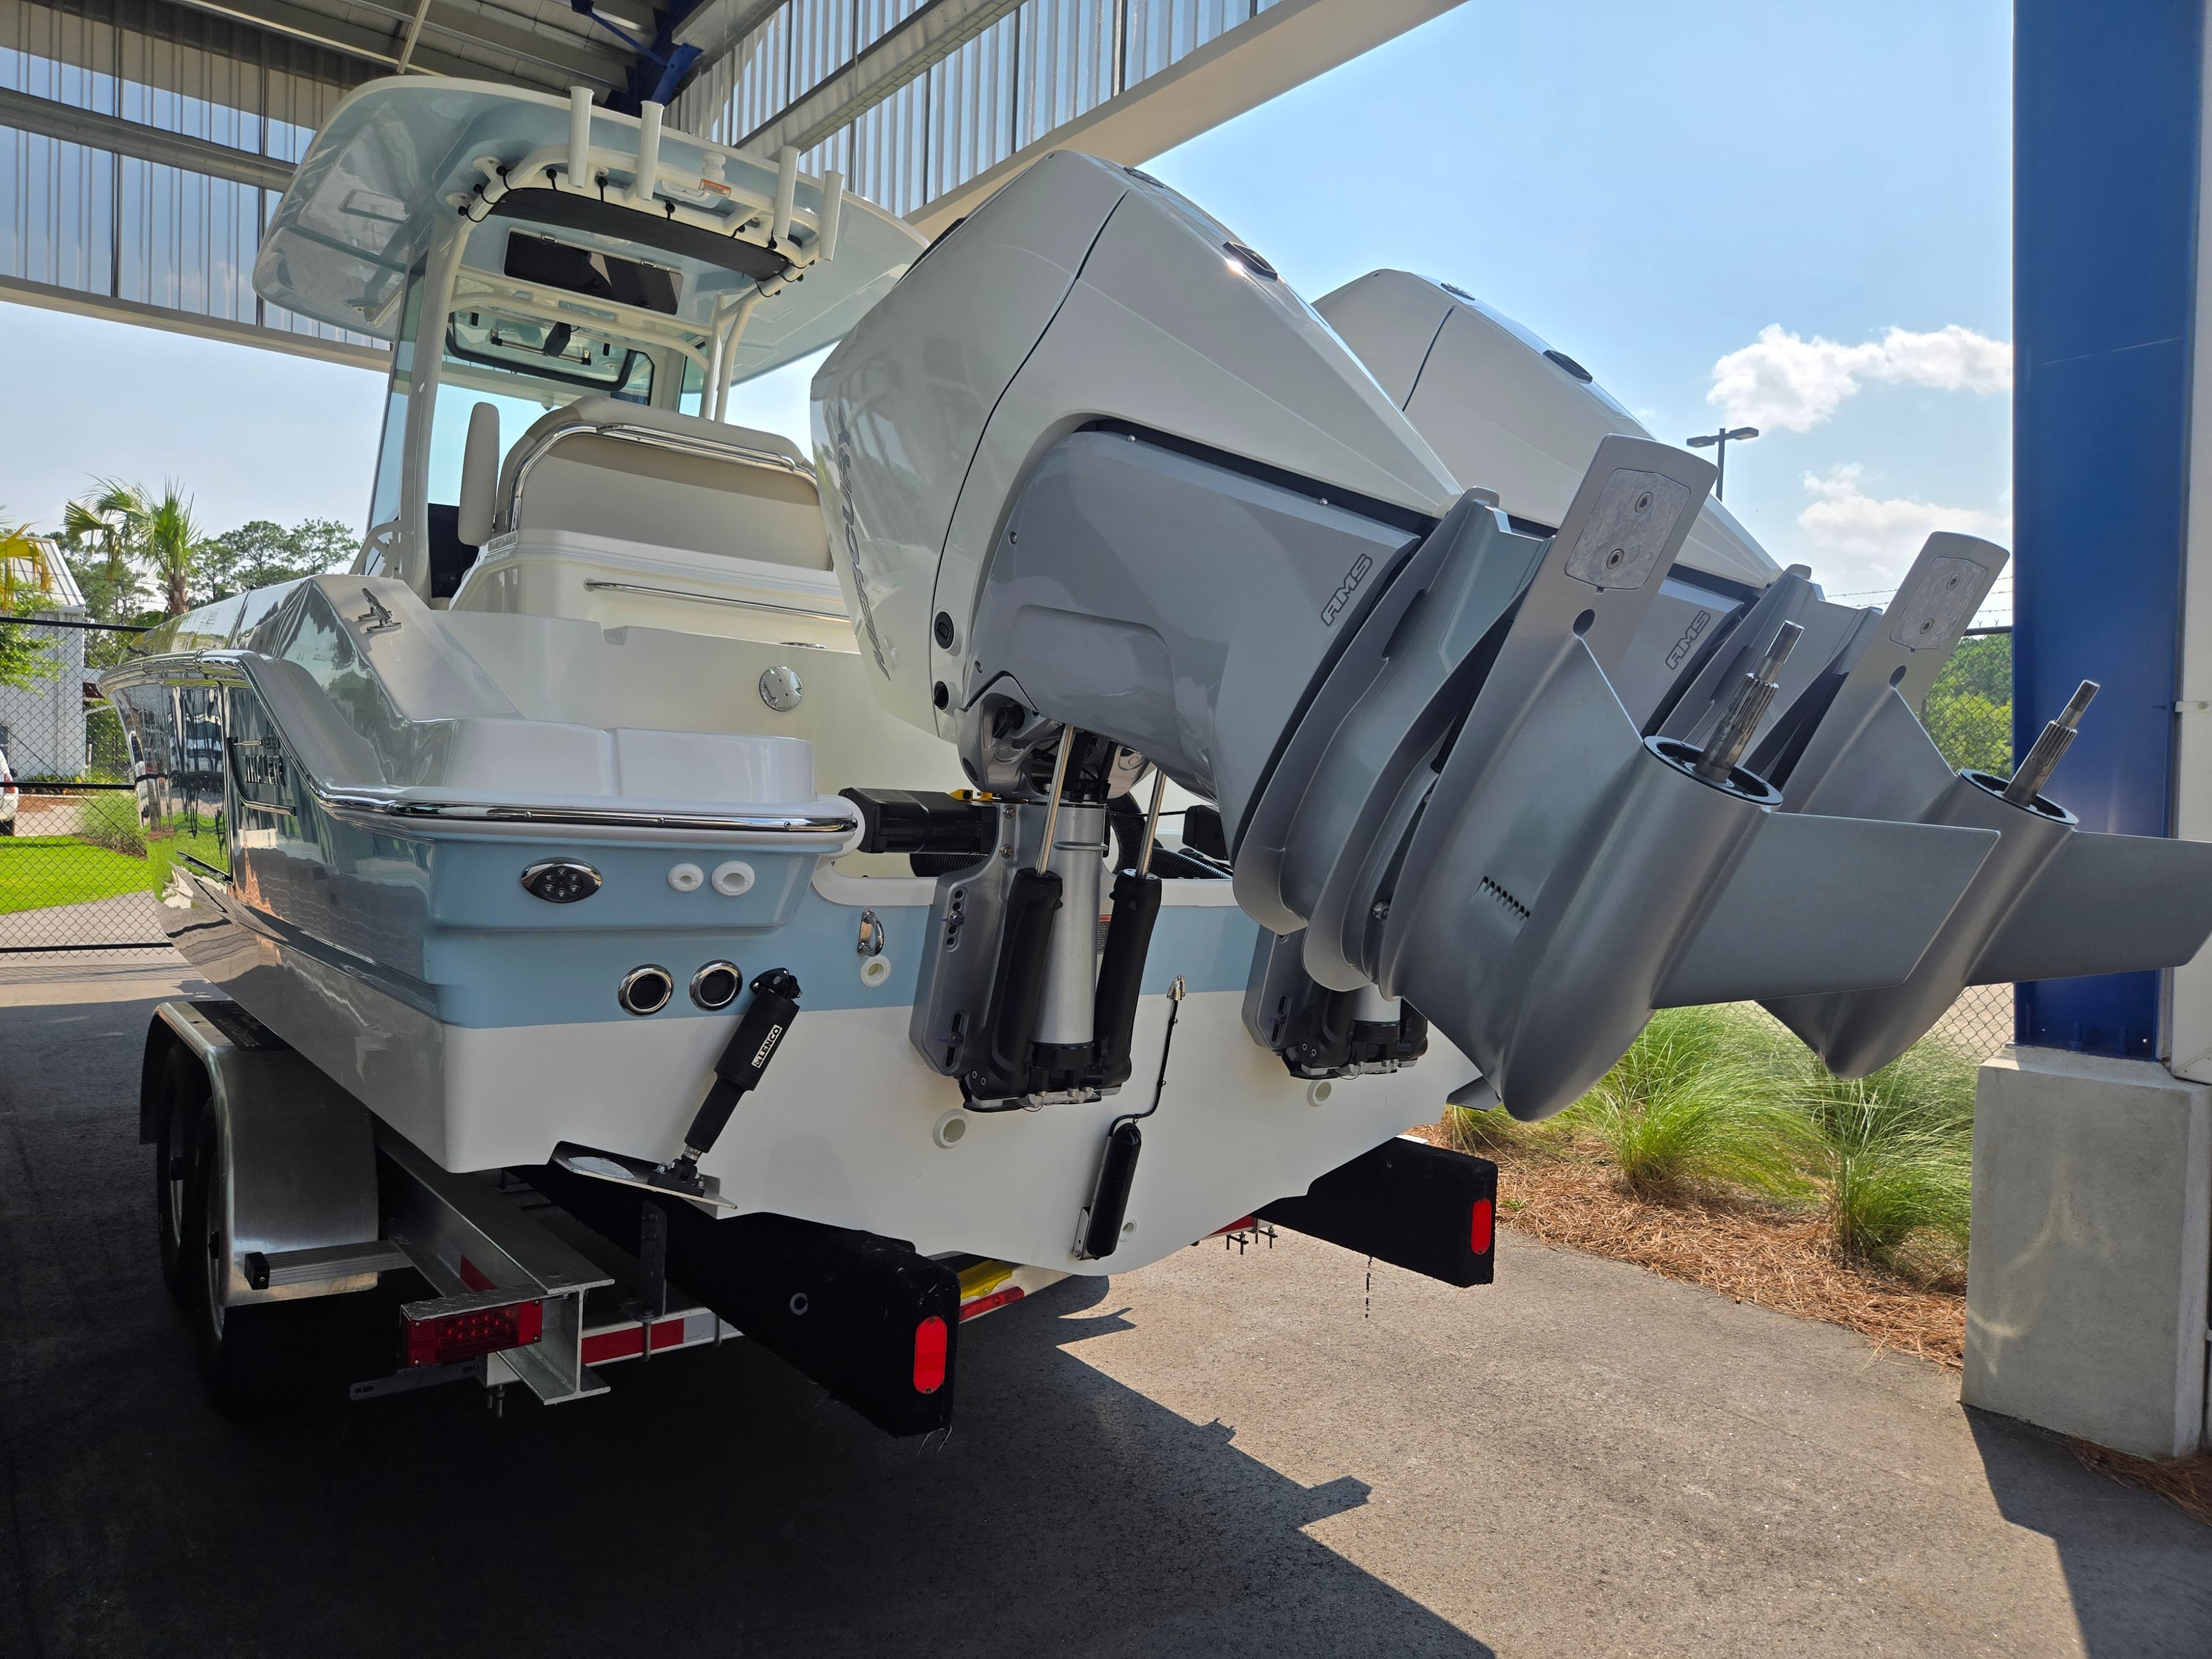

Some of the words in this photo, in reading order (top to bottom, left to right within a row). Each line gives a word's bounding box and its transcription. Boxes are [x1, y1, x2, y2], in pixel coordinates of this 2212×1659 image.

[838, 405, 891, 682] MERCURY
[1320, 553, 1373, 627] AMS
[1665, 610, 1711, 670] AMS
[757, 1027, 781, 1059] LENCO
